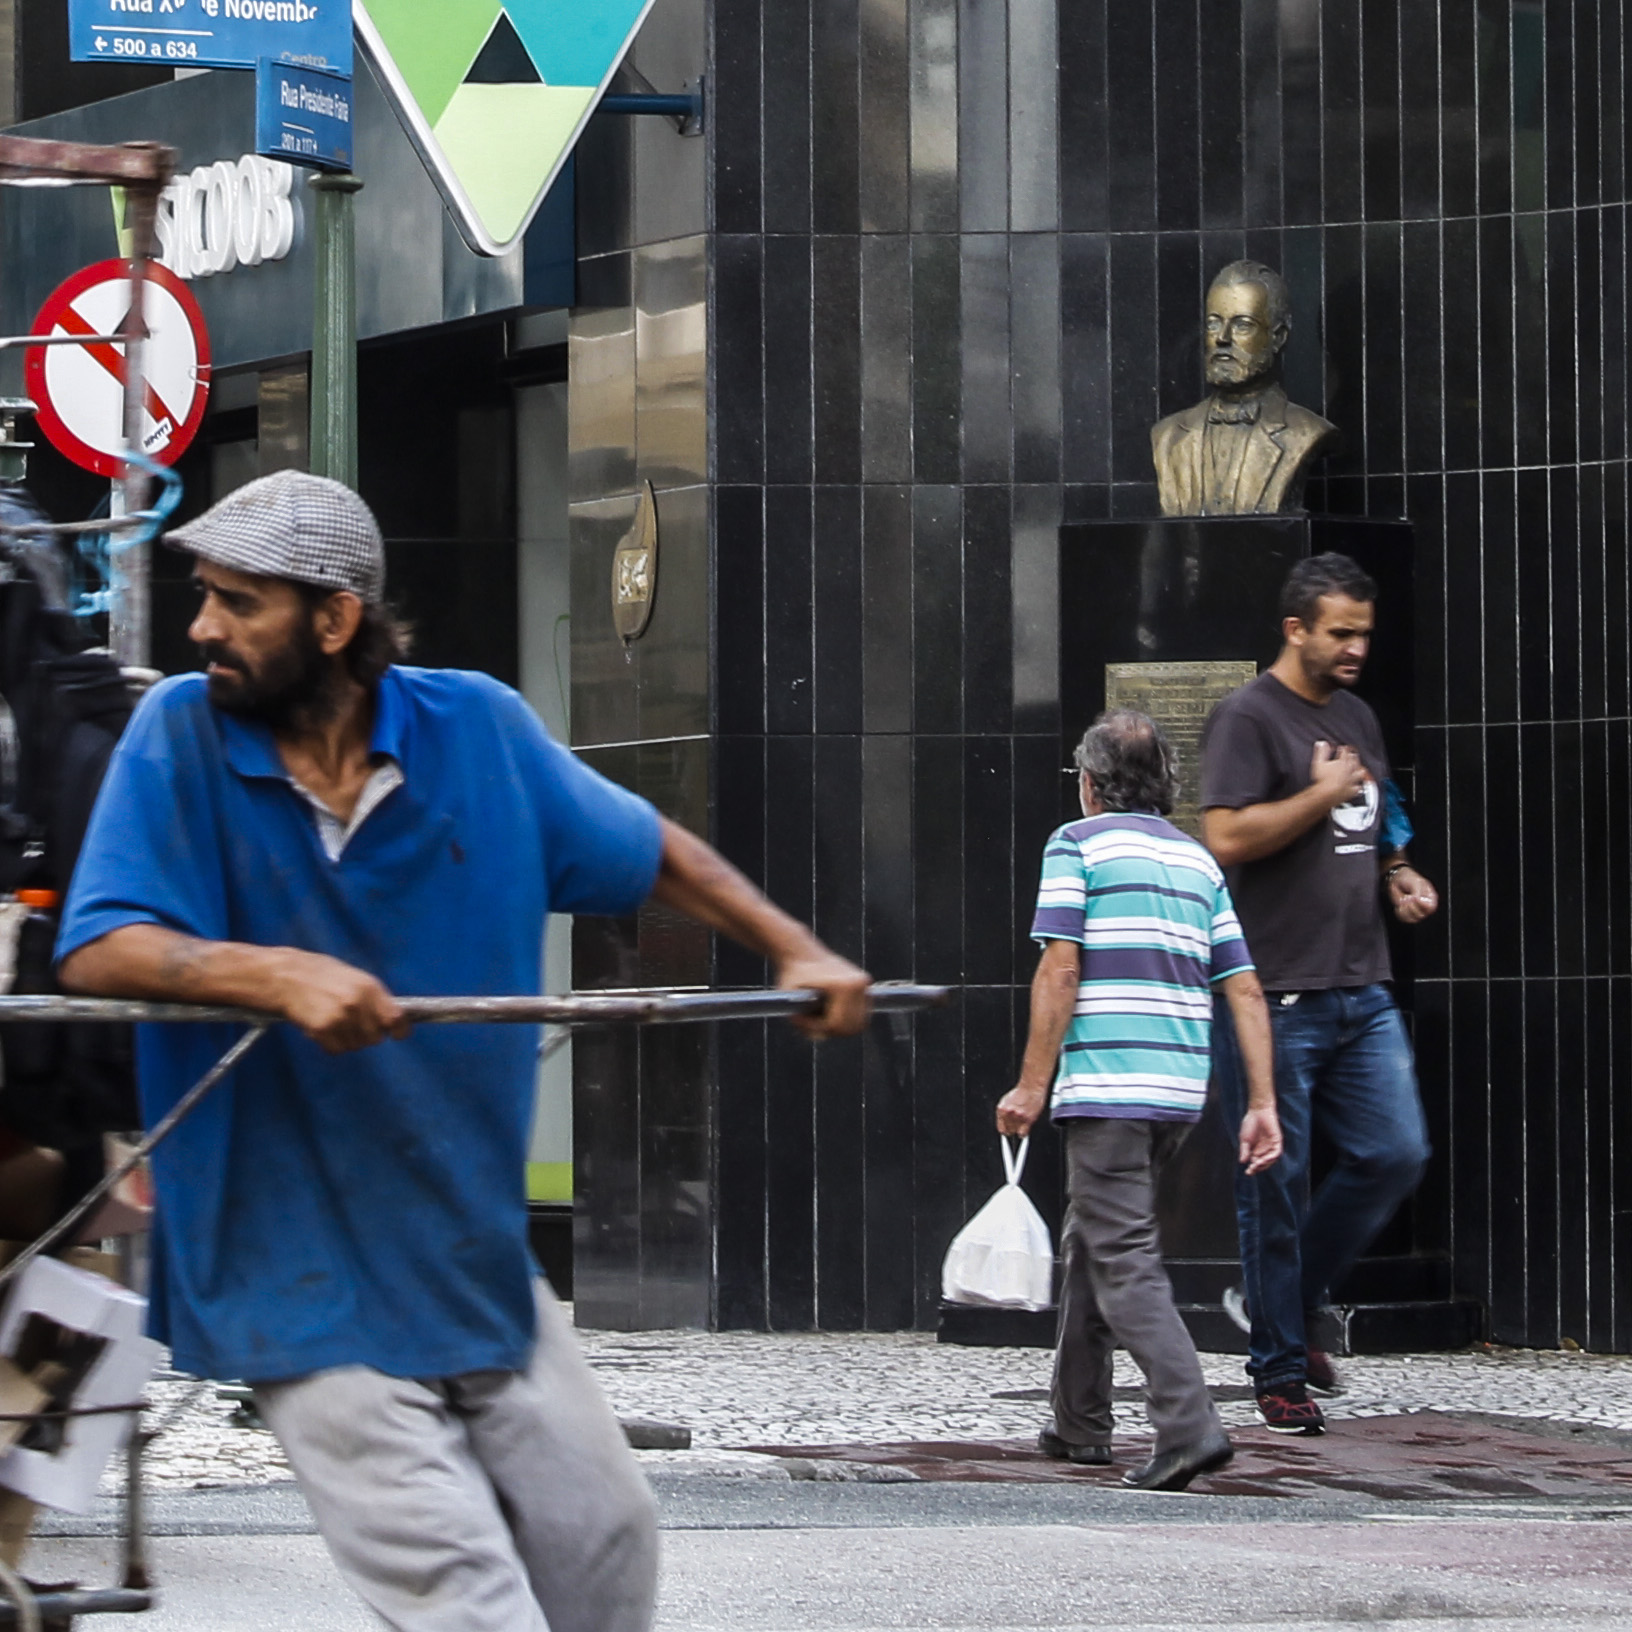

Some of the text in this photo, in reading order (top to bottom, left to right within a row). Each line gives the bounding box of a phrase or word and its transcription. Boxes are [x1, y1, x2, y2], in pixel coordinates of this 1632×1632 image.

[113, 37, 198, 58] 500 a 634
[280, 79, 298, 109] Rua
